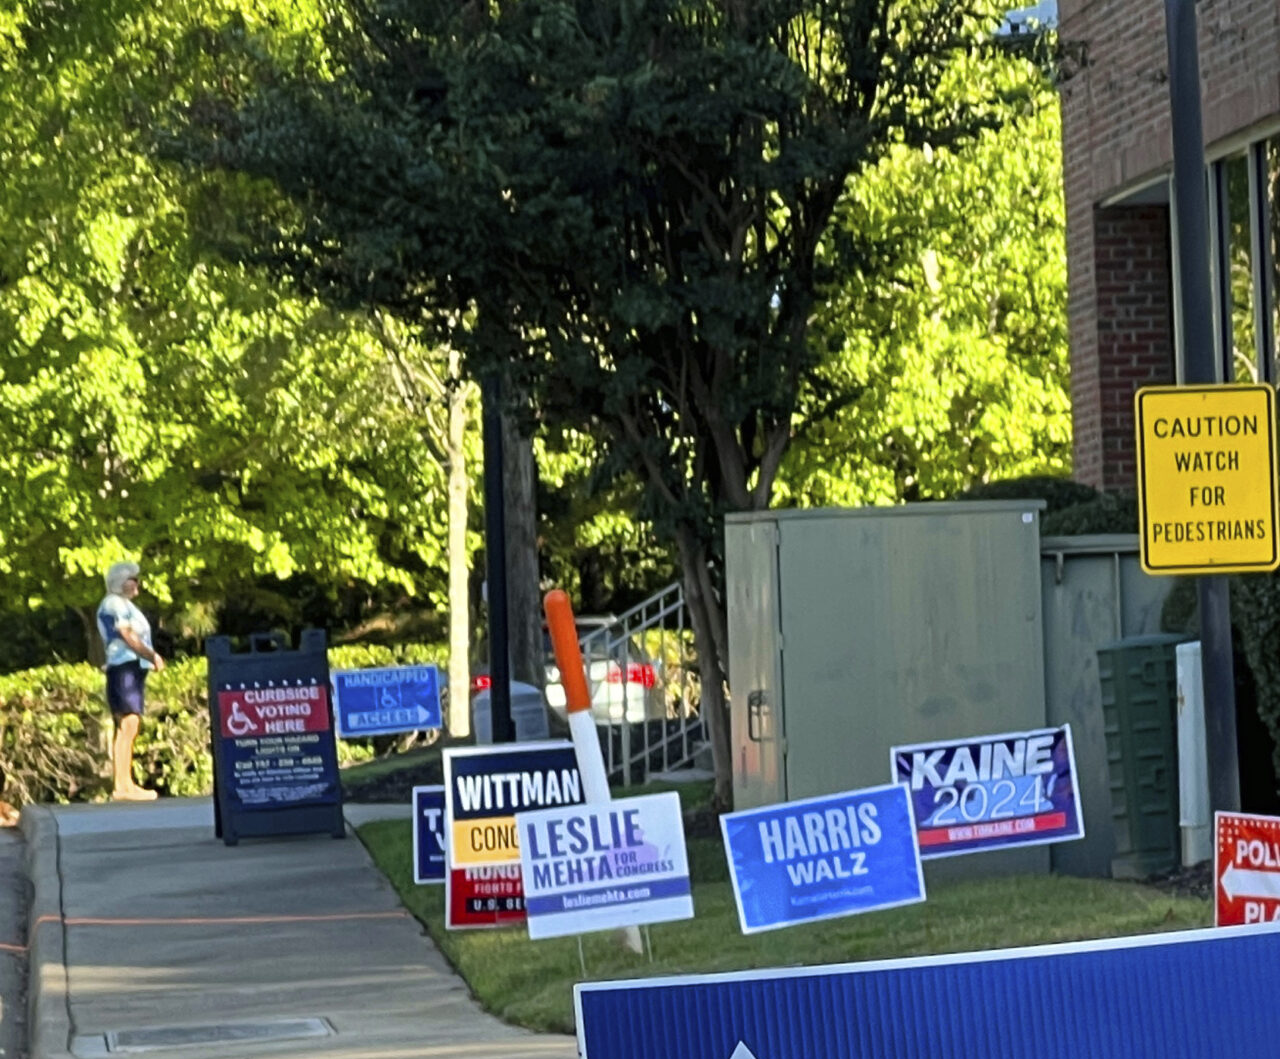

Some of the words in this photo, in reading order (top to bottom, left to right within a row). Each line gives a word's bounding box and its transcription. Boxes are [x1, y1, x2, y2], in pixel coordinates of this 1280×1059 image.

[1154, 415, 1258, 438] CAUTION
[1174, 450, 1239, 472] WATCH
[1190, 486, 1226, 506] FOR
[1152, 519, 1266, 543] PEDESTRIANS
[244, 686, 320, 704] CURBSIDE
[255, 702, 311, 717] VOTING
[264, 718, 306, 734] HERE
[911, 735, 1055, 790] KAINE
[457, 769, 580, 811] WITTMAN
[933, 774, 1046, 826] 2024
[527, 808, 643, 860] LESLIE
[758, 802, 882, 863] HARRIS
[615, 851, 637, 864] FOR
[616, 859, 674, 878] CONGRESS
[787, 852, 869, 886] WALZ
[532, 854, 613, 890] MEHTA
[562, 887, 650, 909] lesliemehta.com
